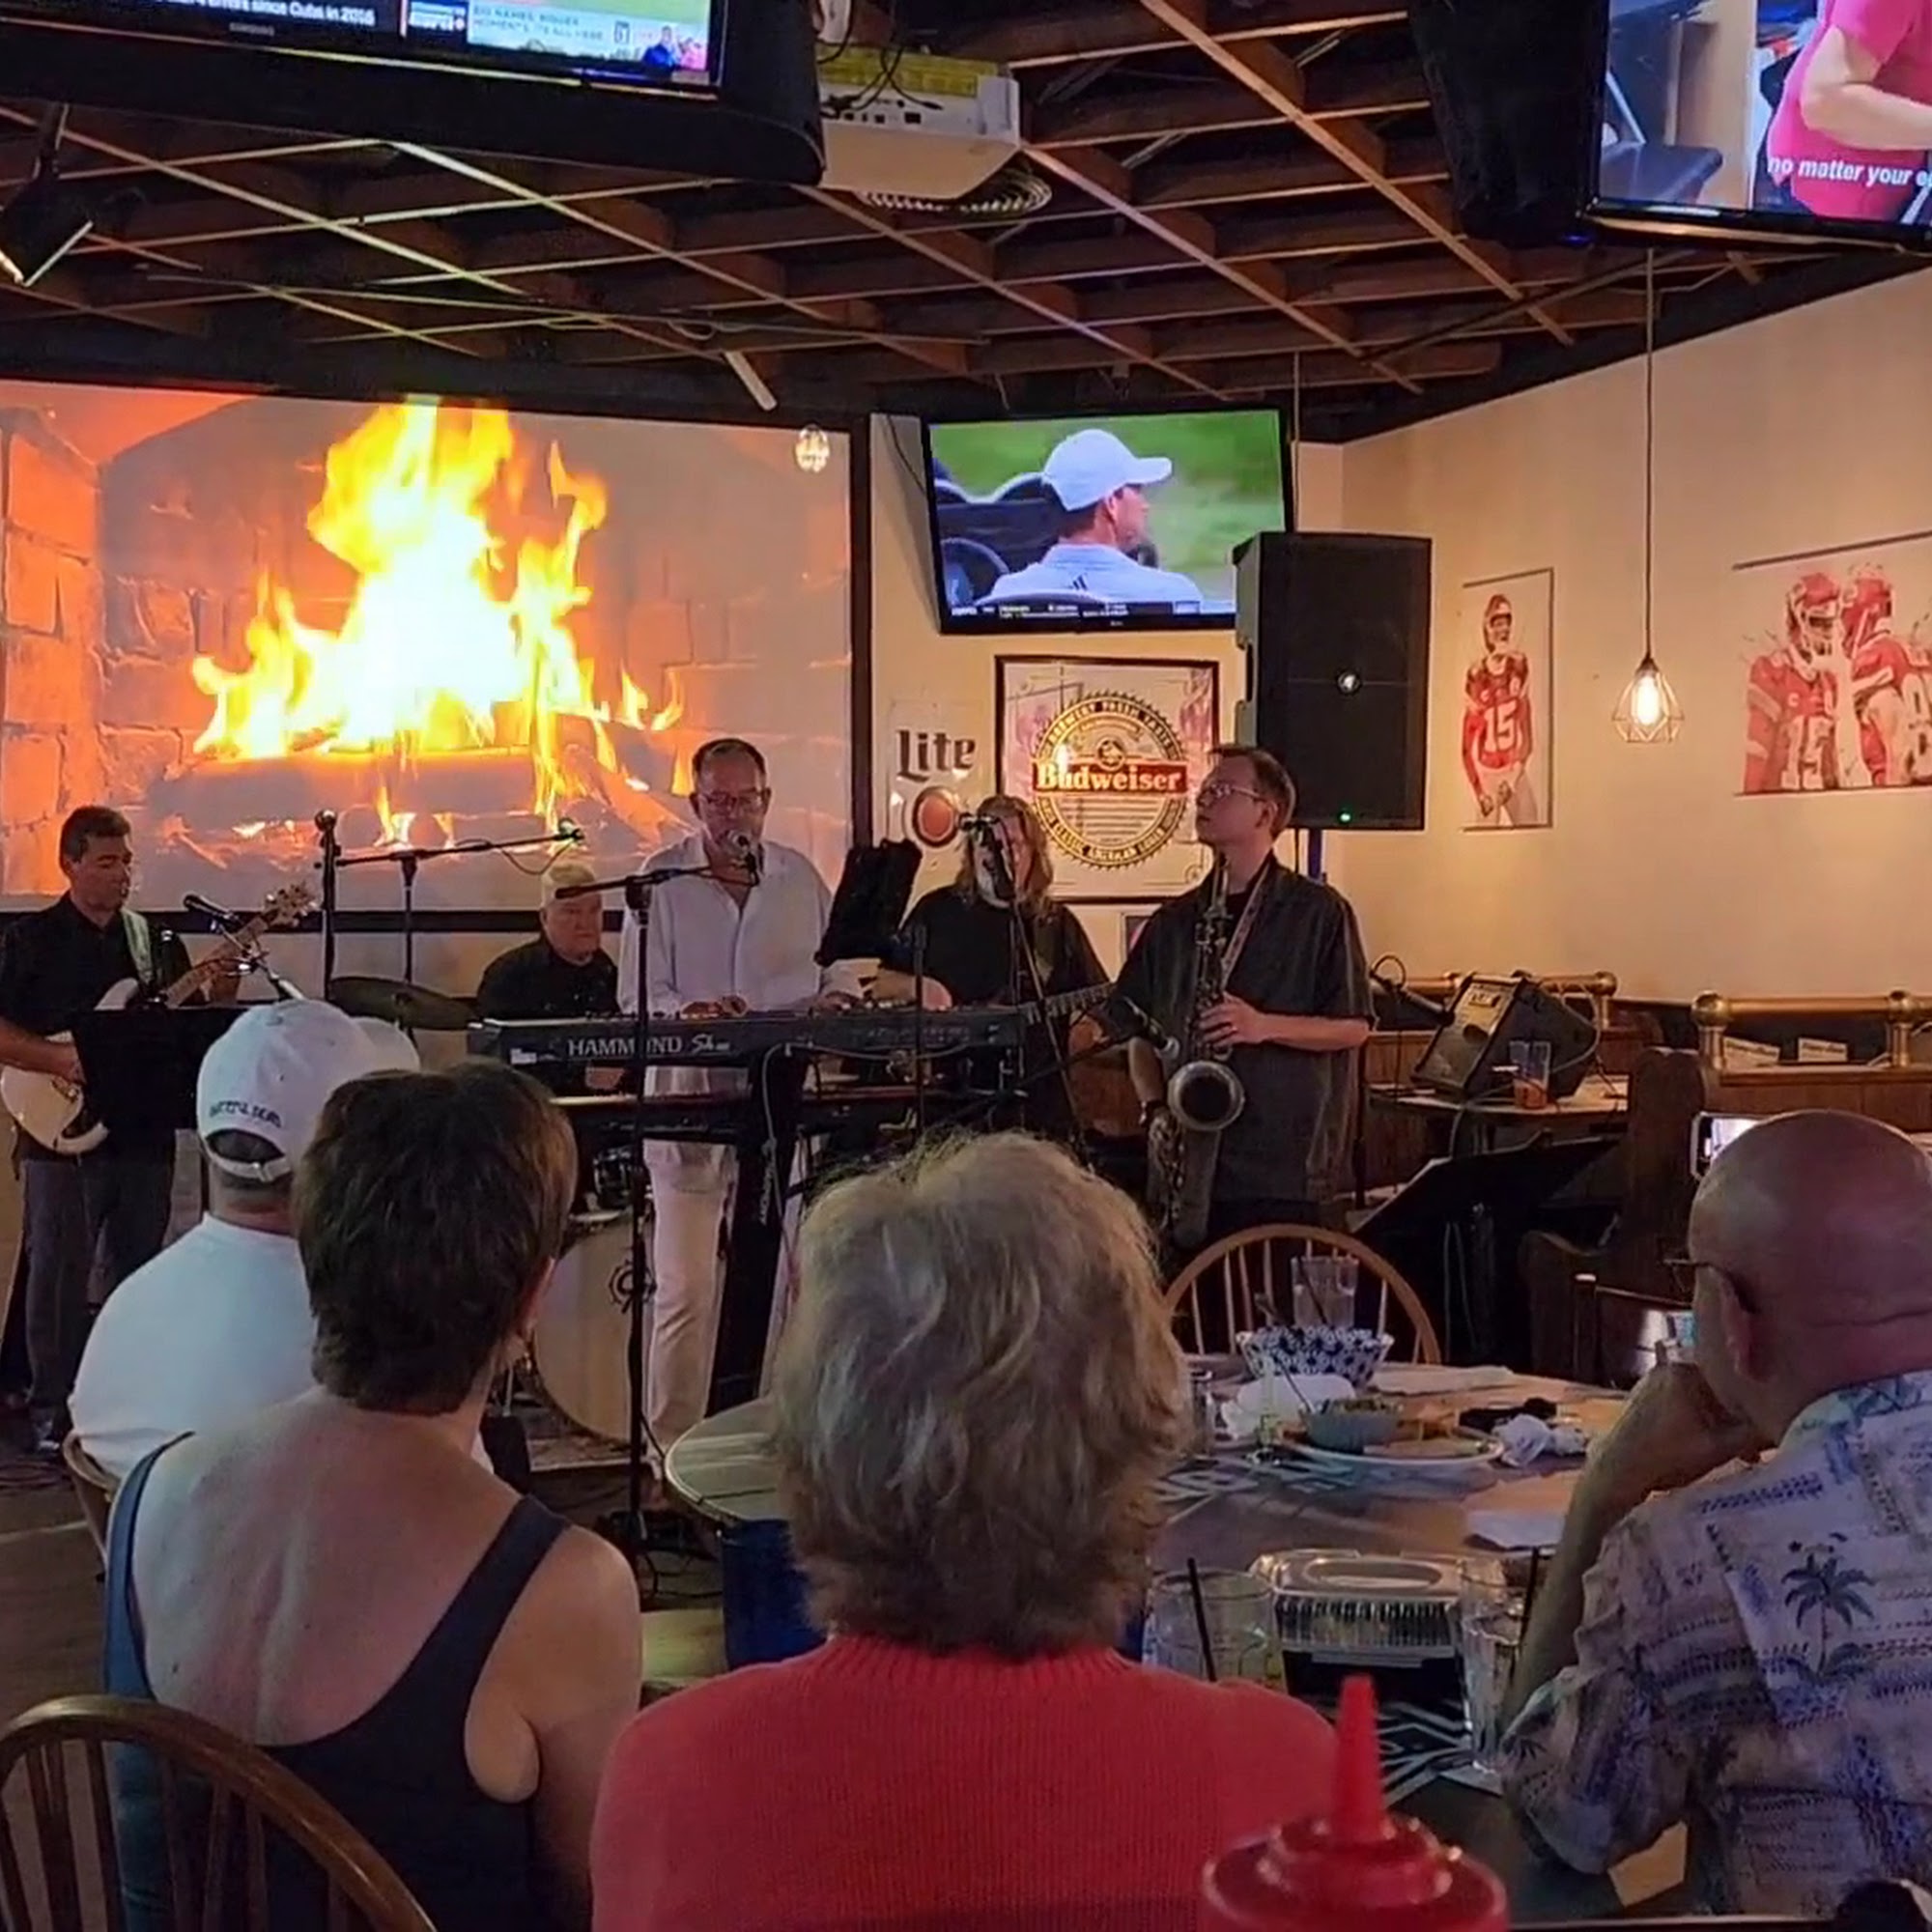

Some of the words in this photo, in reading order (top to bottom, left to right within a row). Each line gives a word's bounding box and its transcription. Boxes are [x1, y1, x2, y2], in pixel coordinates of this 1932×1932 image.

[1767, 156, 1794, 174] no
[1798, 159, 1865, 182] matter
[1864, 166, 1914, 188] your
[1483, 699, 1518, 753] 15
[895, 729, 976, 782] Lite
[1036, 761, 1181, 791] Budweiser
[567, 1037, 682, 1057] HAMMND
